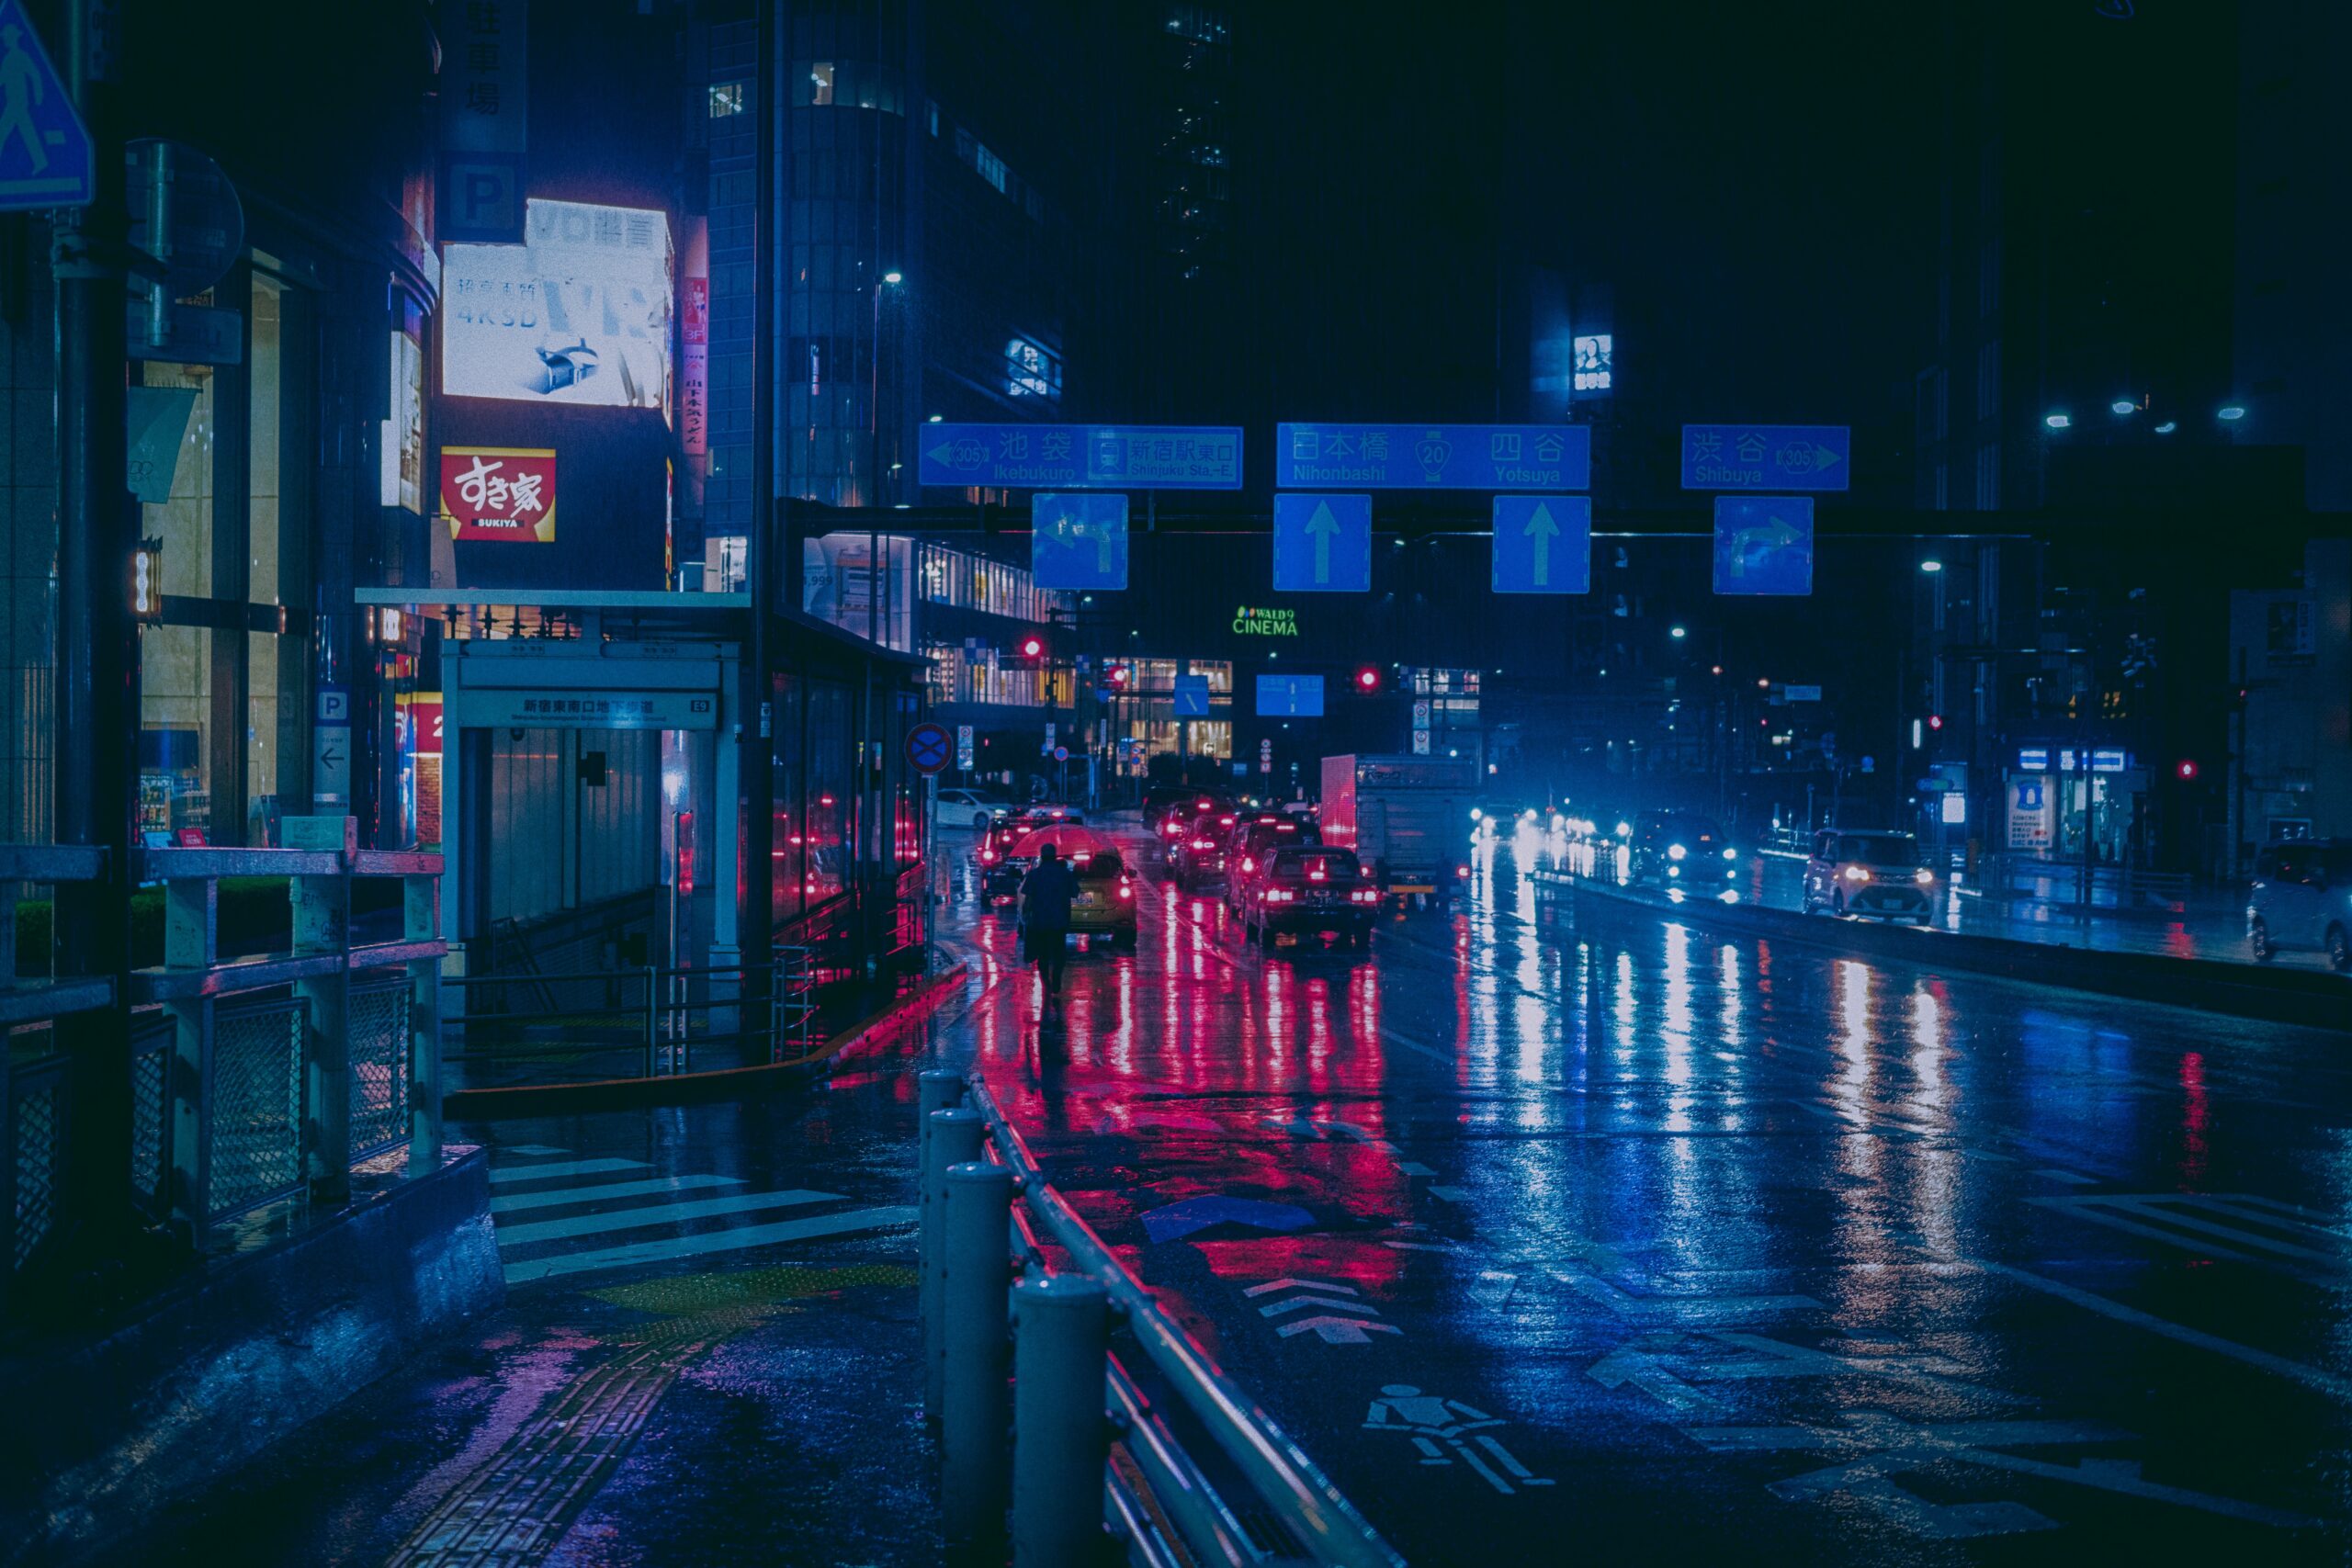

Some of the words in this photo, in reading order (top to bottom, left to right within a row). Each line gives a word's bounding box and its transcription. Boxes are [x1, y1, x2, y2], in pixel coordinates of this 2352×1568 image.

[466, 1, 501, 116] 駐車場
[466, 173, 503, 220] P
[956, 446, 980, 463] 305
[999, 431, 1072, 462] 池袋
[1131, 439, 1234, 463] 新宿駅東口
[1294, 430, 1389, 461] 日本橋
[1422, 446, 1443, 464] 20
[1491, 433, 1565, 462] 四谷
[1692, 432, 1767, 463] 渋谷
[1785, 450, 1811, 466] 305
[994, 463, 1075, 481] Ikebukuro
[1131, 463, 1184, 478] Shinjuku
[1294, 465, 1386, 481] Nihonbashi
[1495, 467, 1560, 486] Yotsuya
[1695, 466, 1762, 486] Shibuya
[454, 456, 544, 518] すき家
[478, 518, 518, 528] SUKIYA
[1256, 608, 1286, 620] WALD
[1286, 609, 1295, 623] 9
[1232, 618, 1298, 637] CINEMA
[326, 697, 340, 715] P
[693, 702, 707, 712] E9
